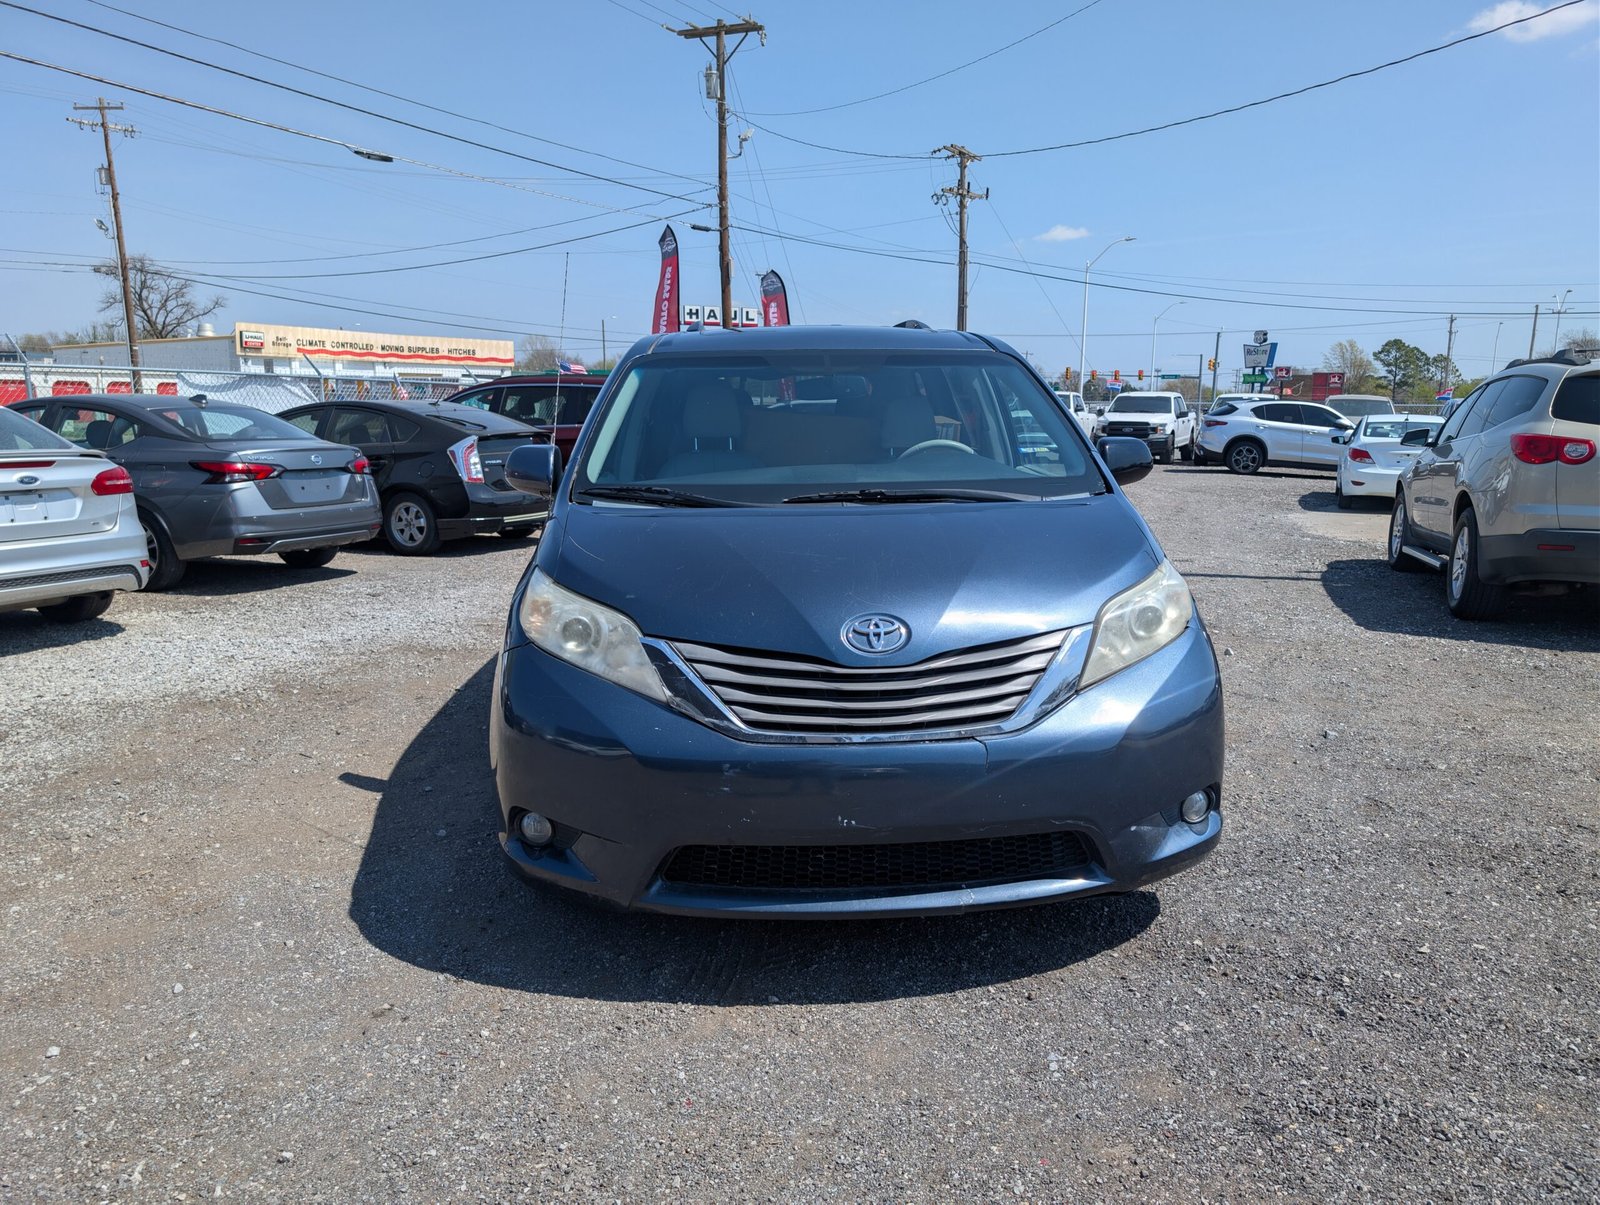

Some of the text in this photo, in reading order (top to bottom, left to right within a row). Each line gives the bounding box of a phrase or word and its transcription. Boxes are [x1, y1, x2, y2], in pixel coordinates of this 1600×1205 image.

[271, 340, 292, 348] Storage
[296, 338, 477, 356] CLIMATE CONTROLLED MOVING SUPPLIES HITCHES
